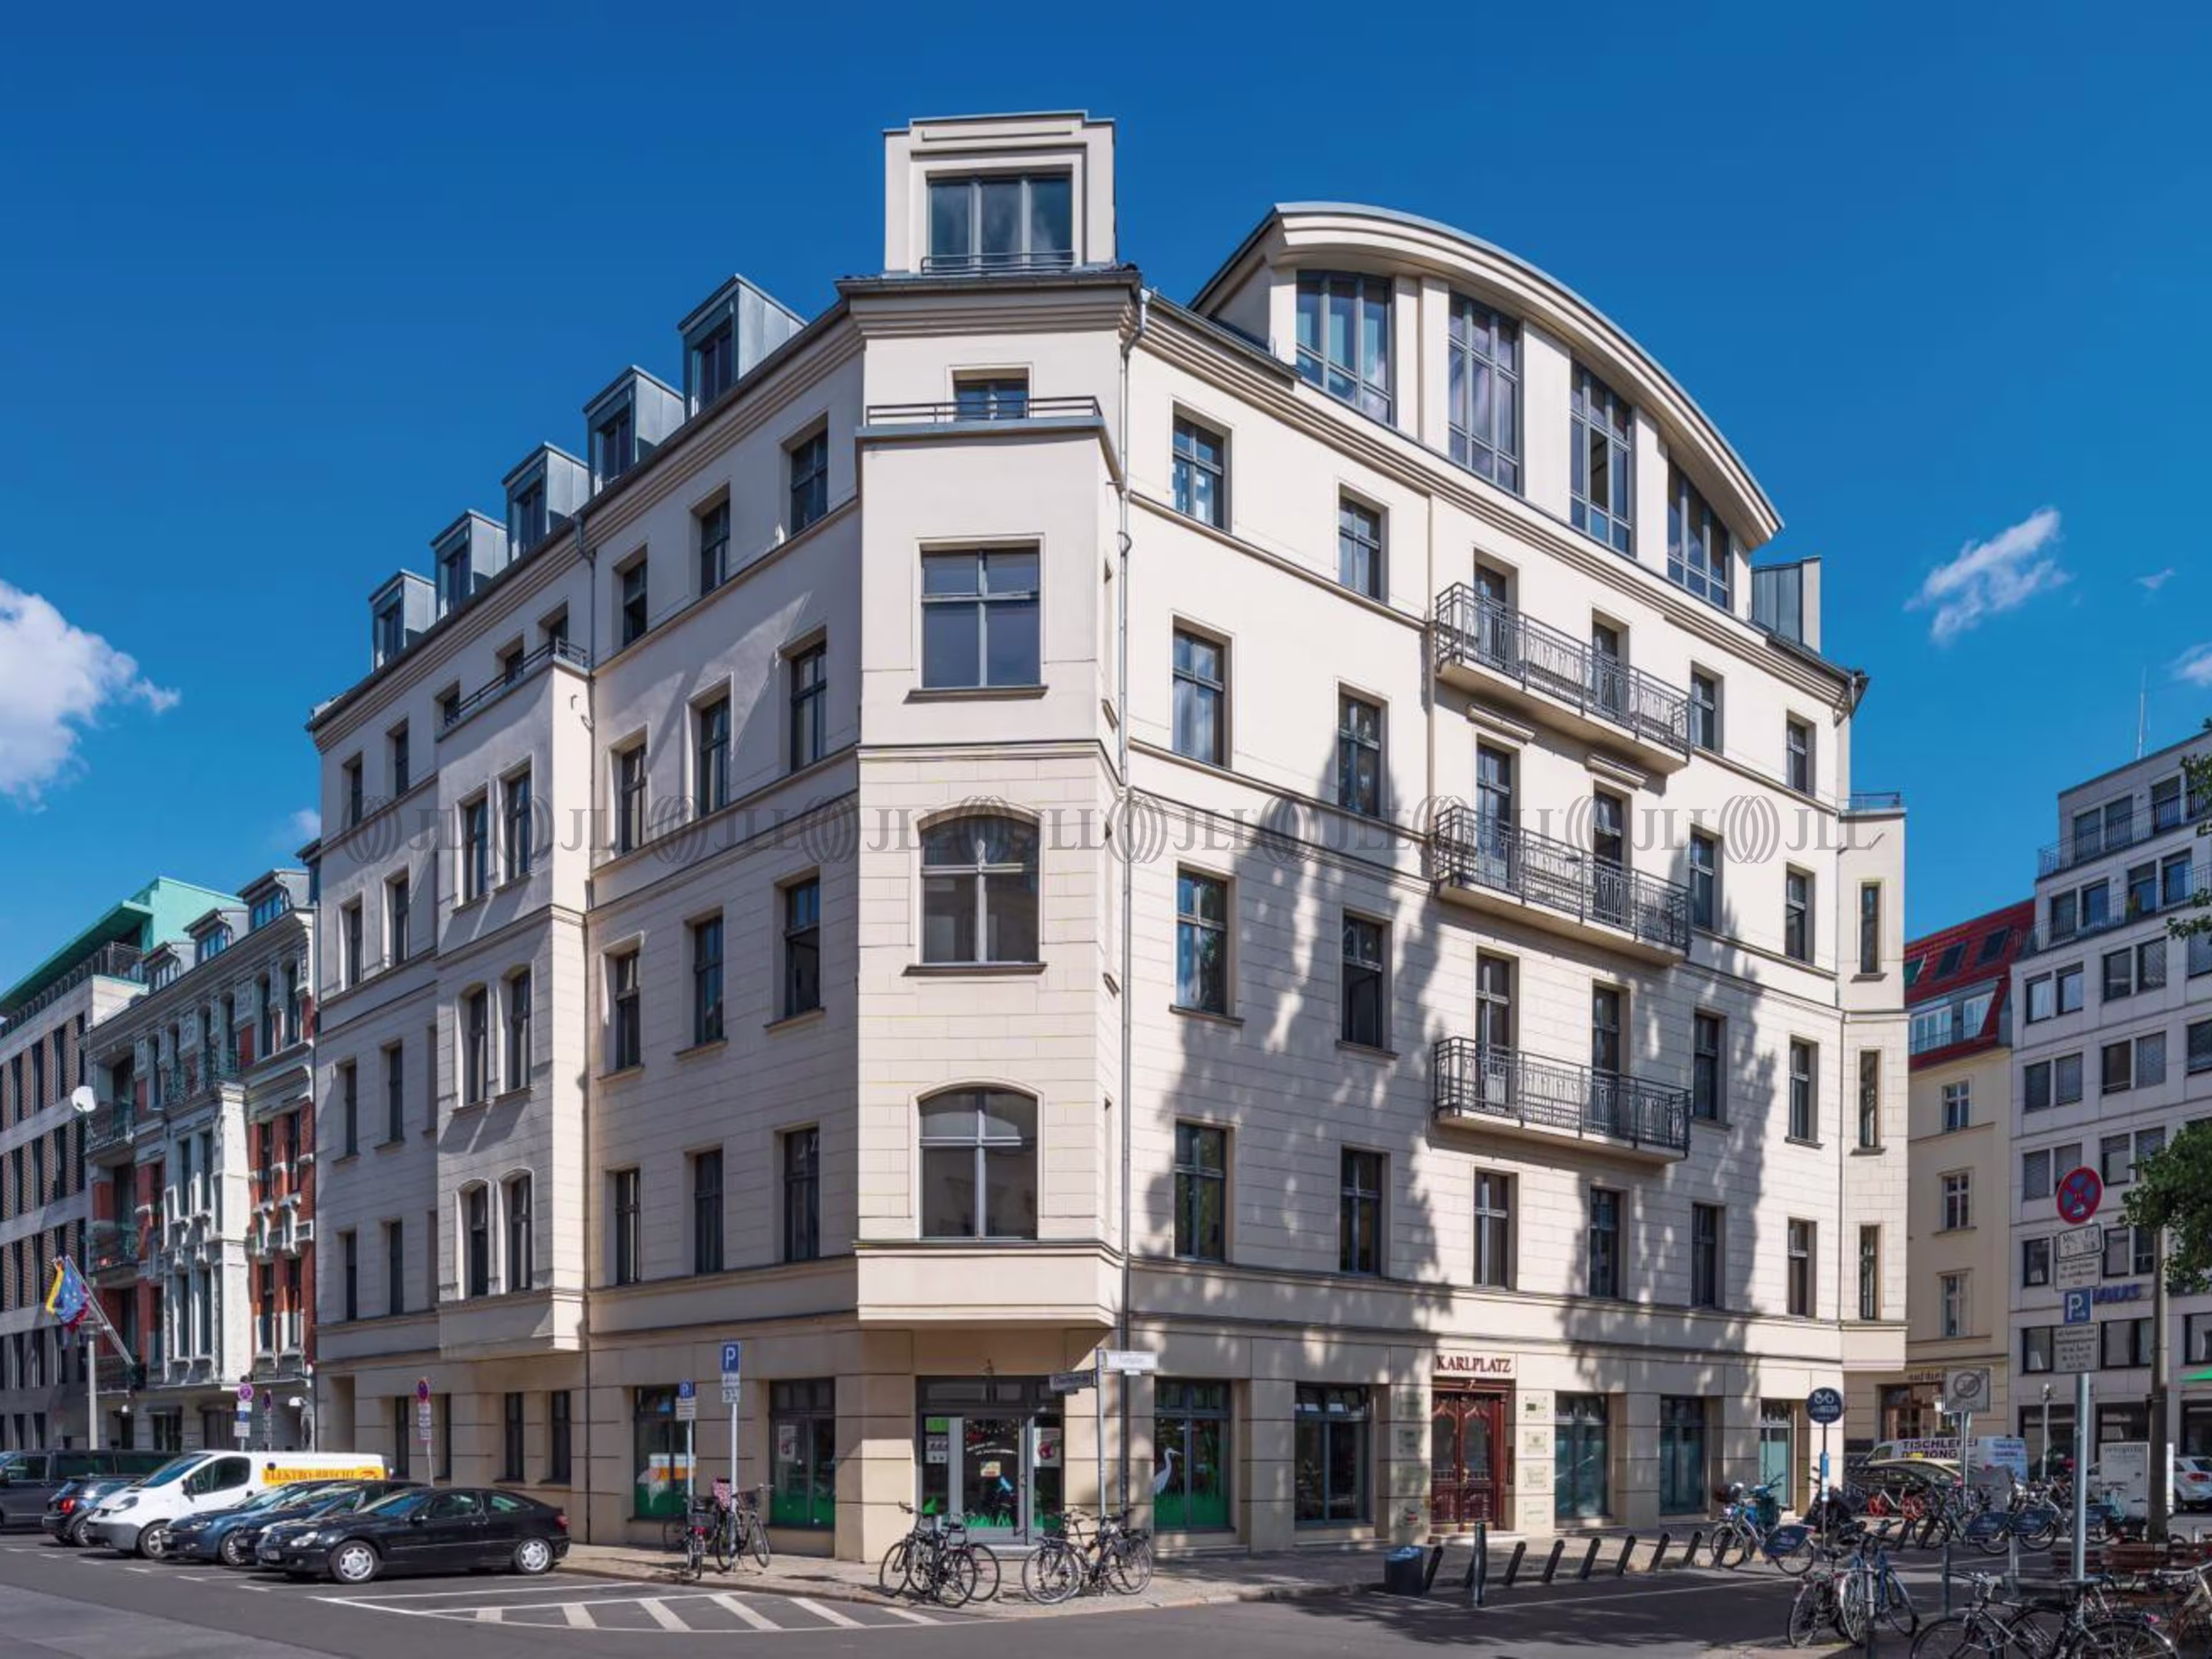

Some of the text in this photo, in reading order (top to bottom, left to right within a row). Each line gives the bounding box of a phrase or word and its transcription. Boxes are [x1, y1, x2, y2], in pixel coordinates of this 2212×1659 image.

[2068, 1294, 2082, 1320] P
[726, 1347, 736, 1369] P
[1437, 1355, 1510, 1372] KARLPLATZ
[1903, 1438, 1978, 1449] TISCHLEEI
